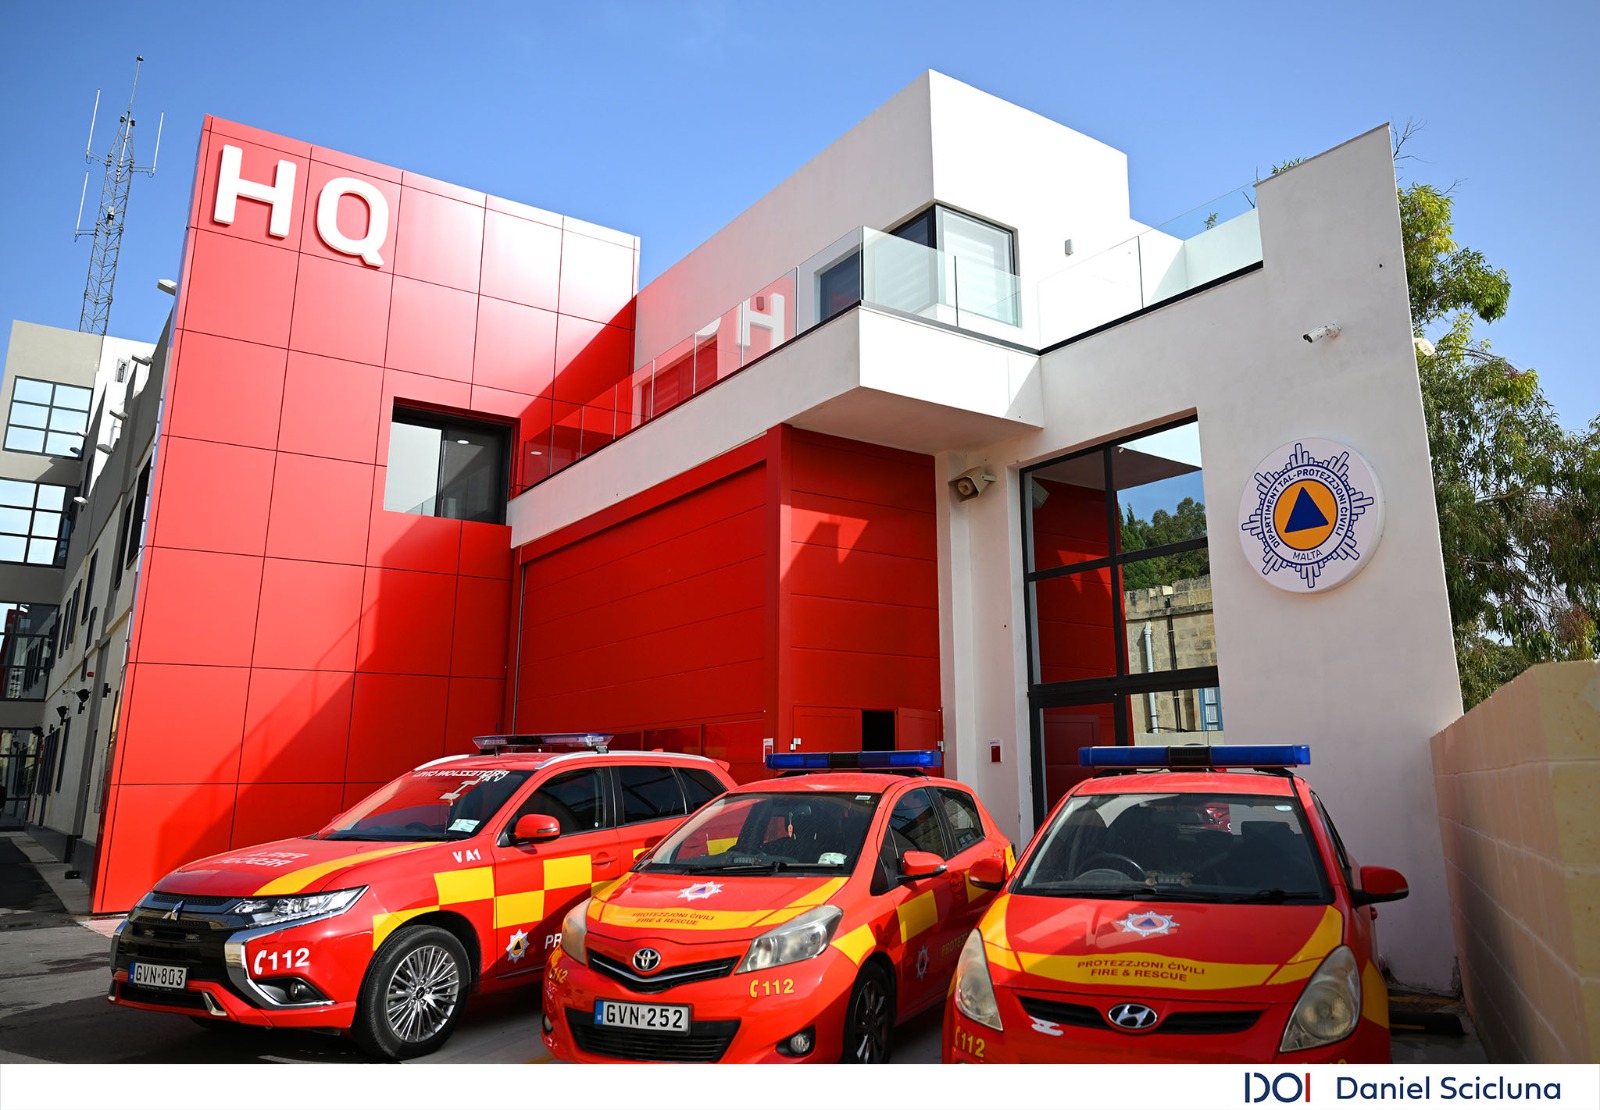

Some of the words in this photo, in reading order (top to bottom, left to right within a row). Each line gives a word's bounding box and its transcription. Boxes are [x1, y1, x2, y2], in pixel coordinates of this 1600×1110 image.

[213, 144, 389, 268] HQ
[1264, 487, 1281, 549] DIPARTIMENT
[1277, 468, 1347, 506] TAL-PROTEZZJONI
[1292, 549, 1323, 561] MALTA
[663, 918, 700, 926] RESCUE
[267, 948, 310, 971] 112
[1077, 959, 1164, 969] PROTEZZJONI
[1090, 968, 1119, 977] FIRE
[1122, 969, 1130, 977] &
[1134, 969, 1188, 982] RESCUE
[762, 978, 795, 996] 112
[961, 1032, 986, 1058] 112
